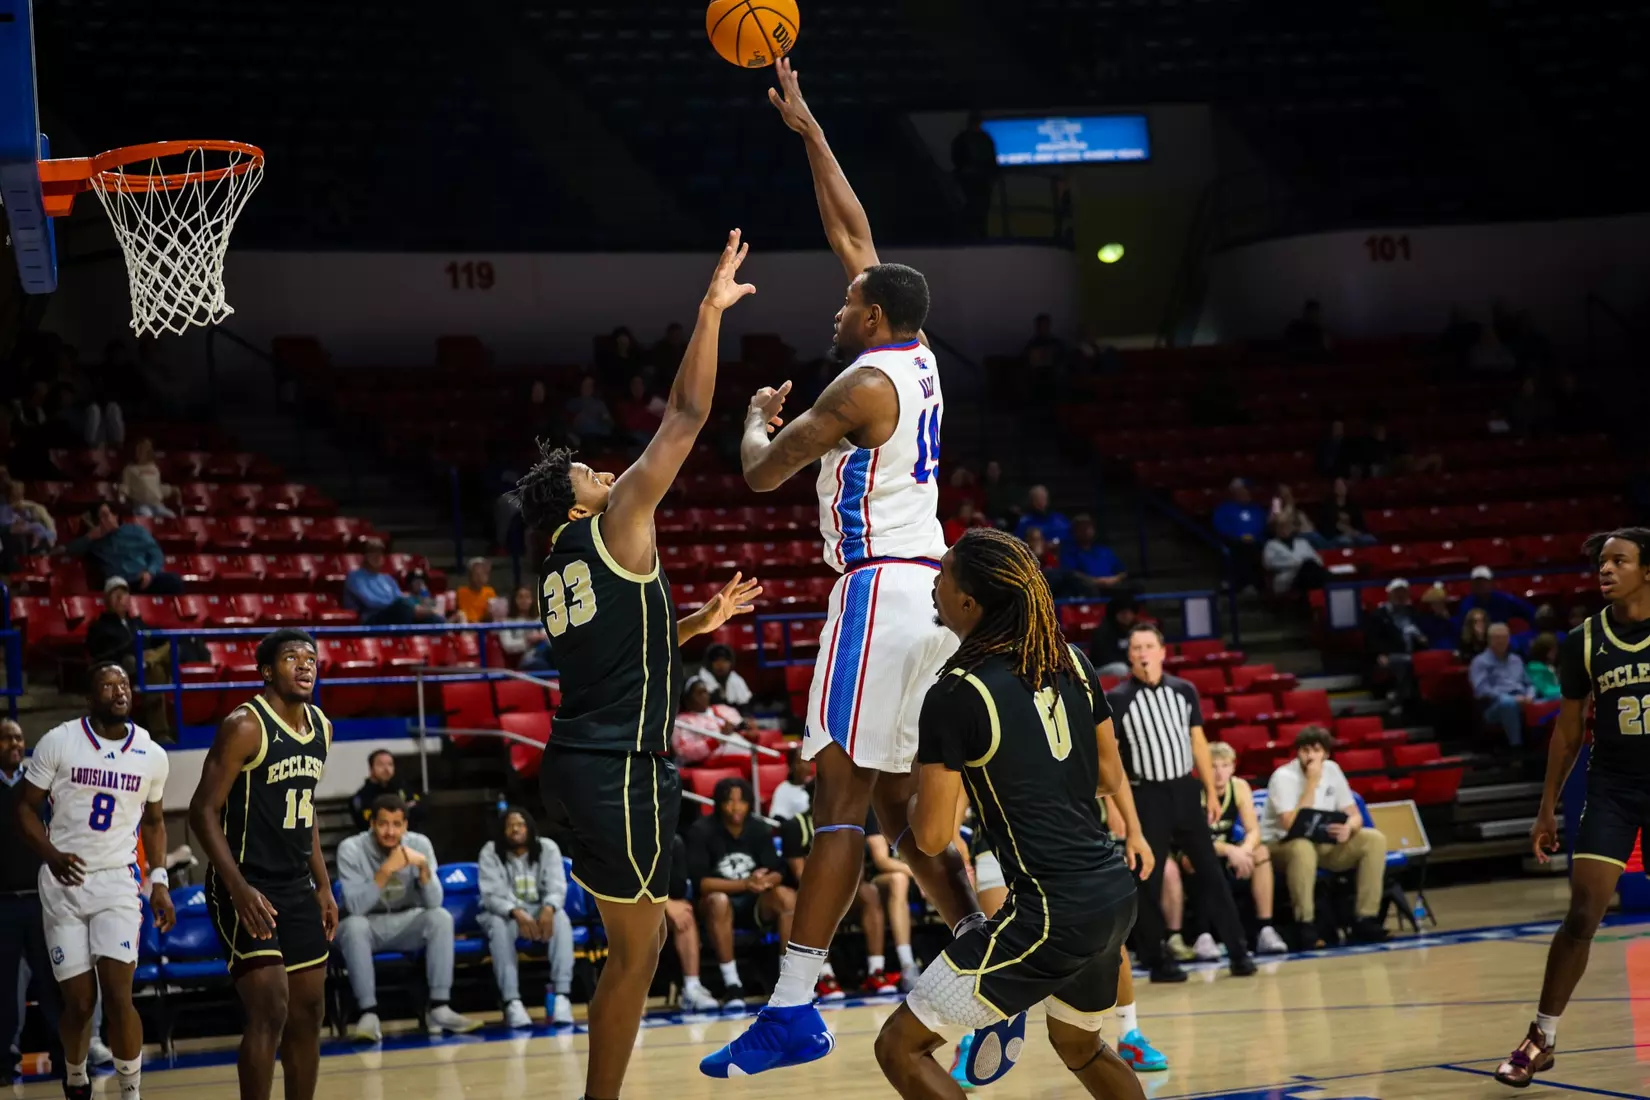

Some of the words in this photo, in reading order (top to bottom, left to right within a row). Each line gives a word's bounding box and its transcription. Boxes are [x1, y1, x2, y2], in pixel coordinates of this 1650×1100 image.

[1364, 235, 1410, 262] 101
[444, 261, 496, 290] 119
[543, 559, 598, 638] 33
[71, 767, 118, 790] LOUISIANA
[120, 772, 142, 793] TECH
[88, 791, 116, 833] 8
[282, 788, 314, 830] 14
